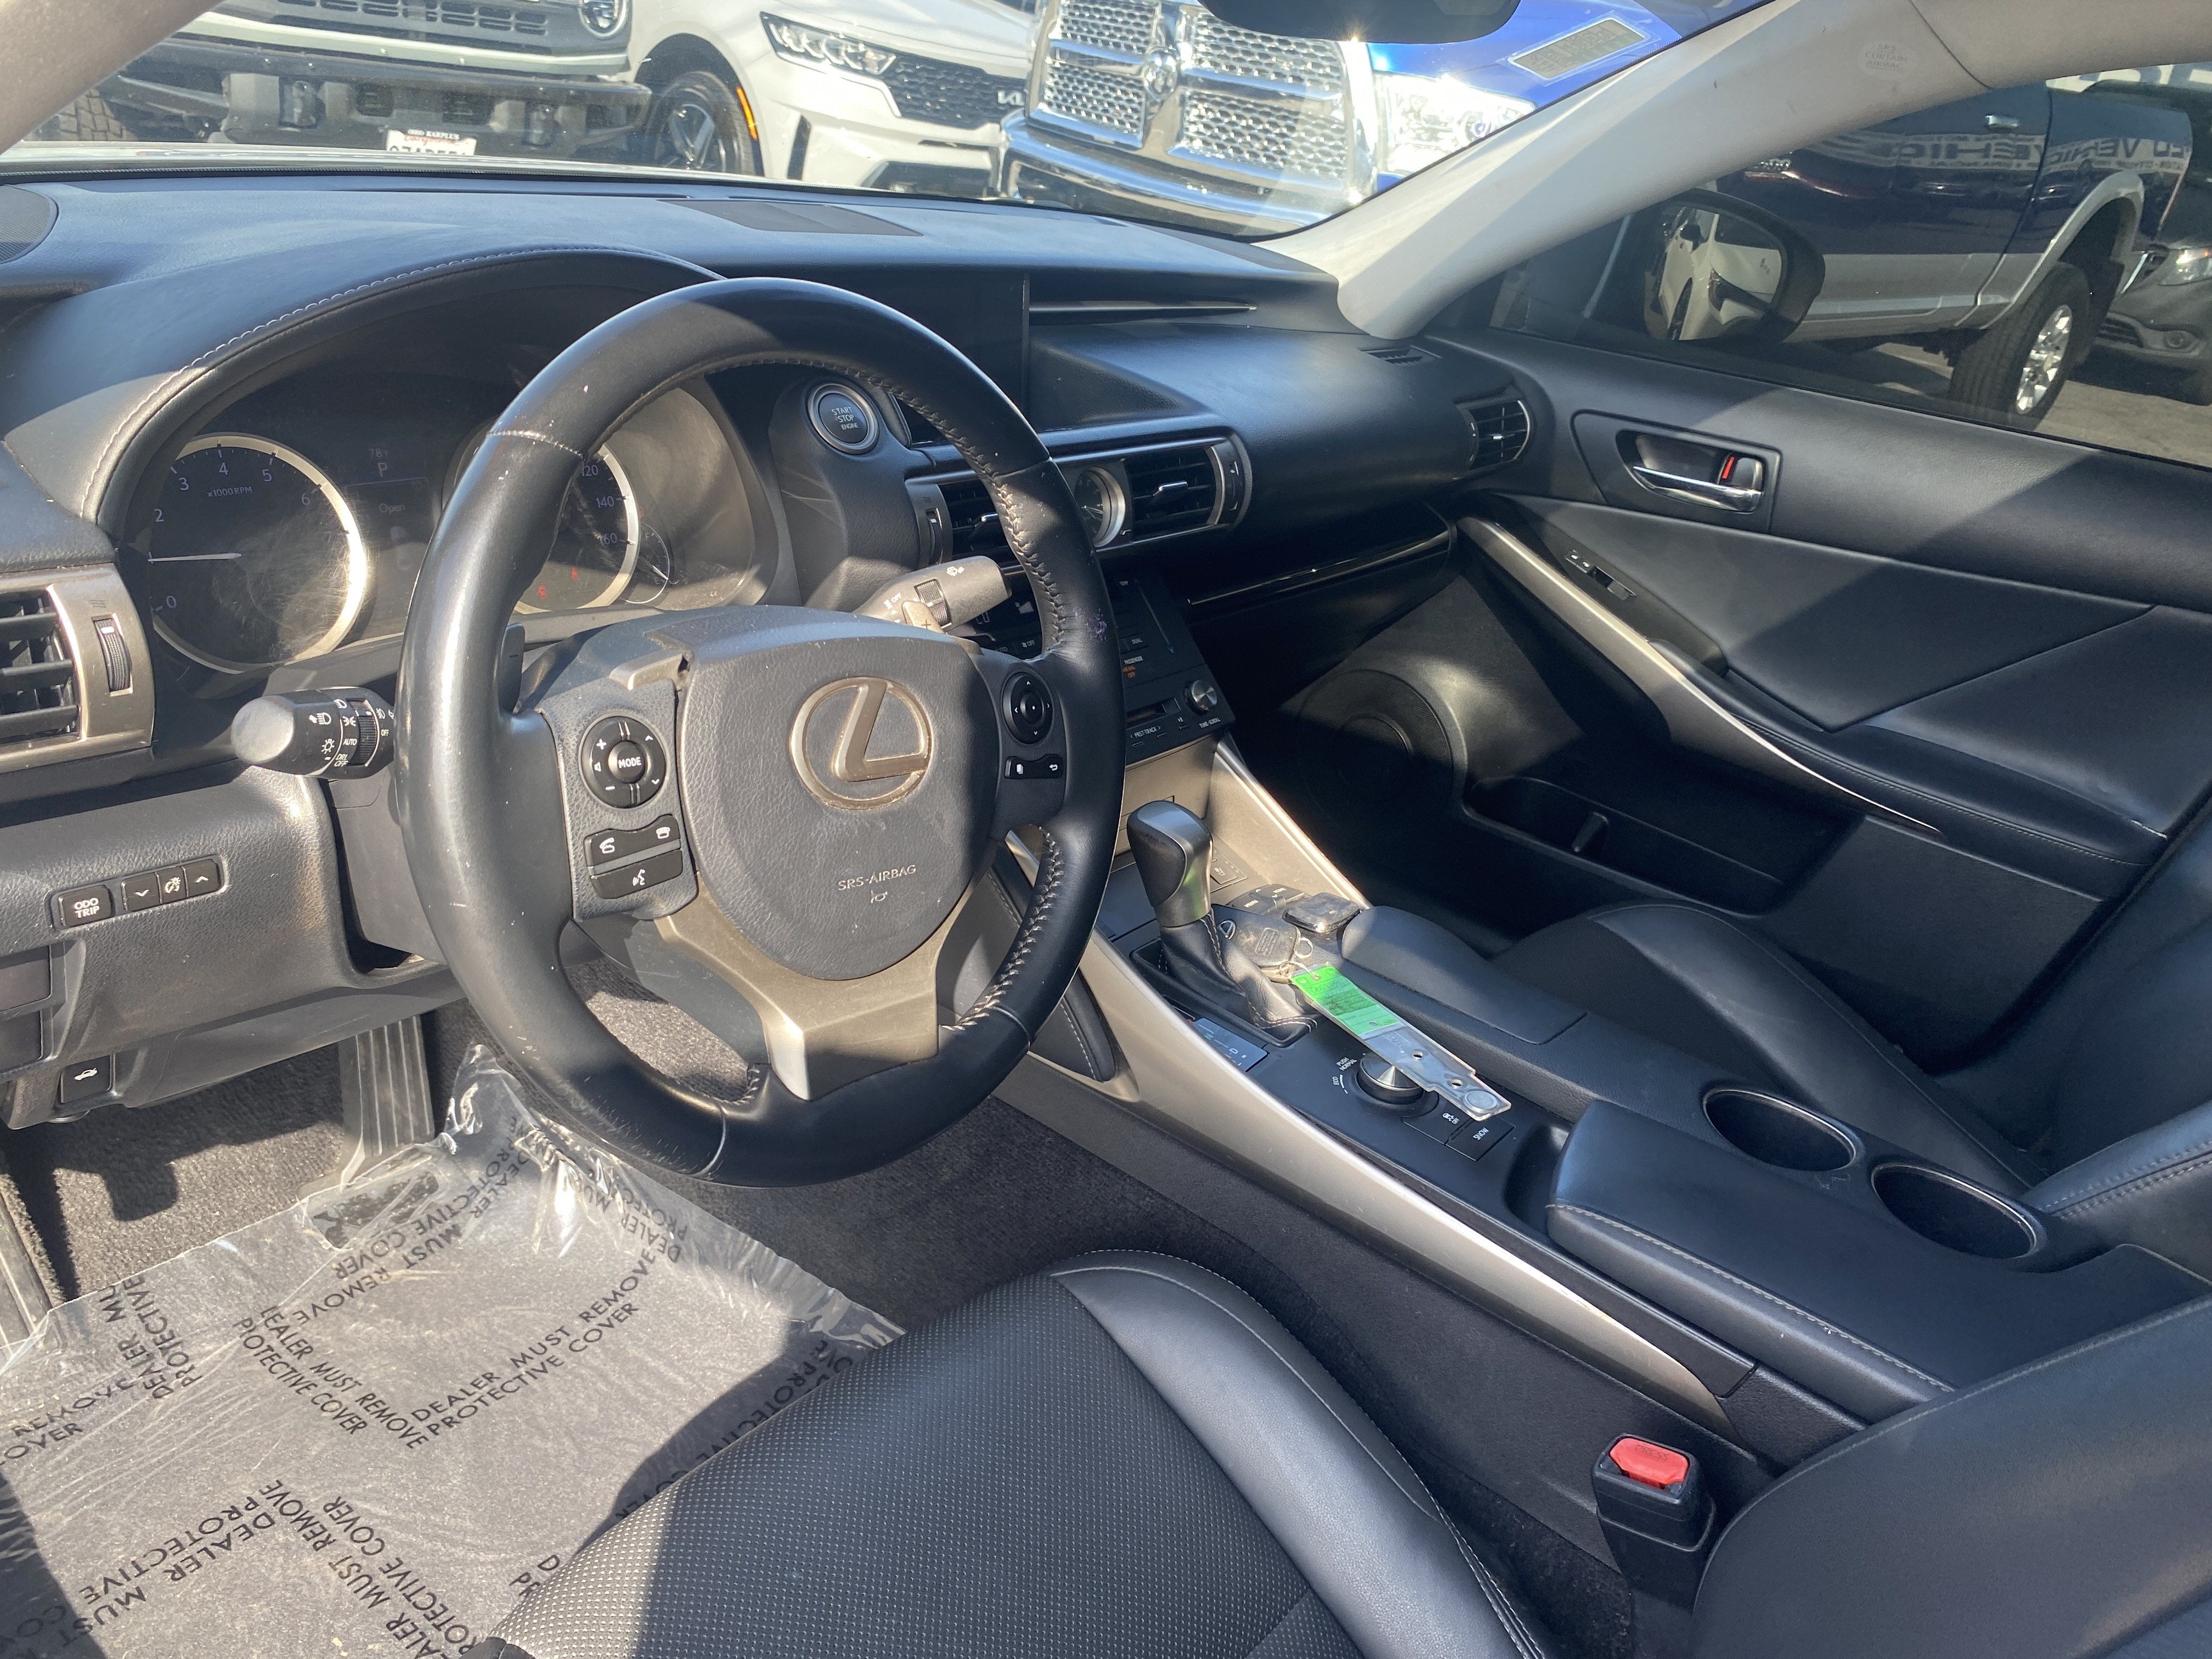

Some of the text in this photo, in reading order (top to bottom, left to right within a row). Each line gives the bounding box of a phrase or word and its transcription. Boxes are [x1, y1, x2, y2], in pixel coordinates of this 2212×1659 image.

[831, 406, 853, 416] START
[837, 414, 855, 423] STOP
[840, 422, 860, 431] ENGINE
[219, 462, 229, 476] 4
[262, 468, 273, 482] 5
[377, 462, 388, 478] P
[178, 477, 189, 491] 3
[301, 493, 311, 506] 6
[595, 495, 614, 509] 140
[154, 508, 165, 522] 2
[379, 503, 405, 515] Open
[166, 595, 177, 608] 0
[343, 738, 358, 746] AUTO
[335, 753, 348, 761] DRL
[618, 756, 642, 769] MODE
[74, 897, 99, 911] ODO
[75, 905, 100, 919] TRIP
[1336, 1057, 1350, 1066] PUSH
[1472, 1126, 1489, 1141] SNOW
[402, 1223, 463, 1268] MUST
[335, 1231, 406, 1280] COVER
[292, 1267, 392, 1325] REMOVE
[122, 1273, 204, 1388] PROTECTIVE
[411, 1248, 657, 1422] DEALER MUST REMOVE
[426, 1302, 640, 1436] PROTECTIVE COVER
[309, 1361, 363, 1392] MUST
[354, 1392, 430, 1449] REMOVE
[310, 1392, 369, 1435] COVER
[0, 1423, 83, 1466] OVER
[1634, 1444, 1671, 1461] PRESS
[258, 1479, 337, 1553] REMOVE
[323, 1496, 385, 1557] COVER
[78, 1496, 260, 1605] PROTECTIVE
[59, 1511, 275, 1646] DEALER MUST
[329, 1555, 390, 1610] MUST
